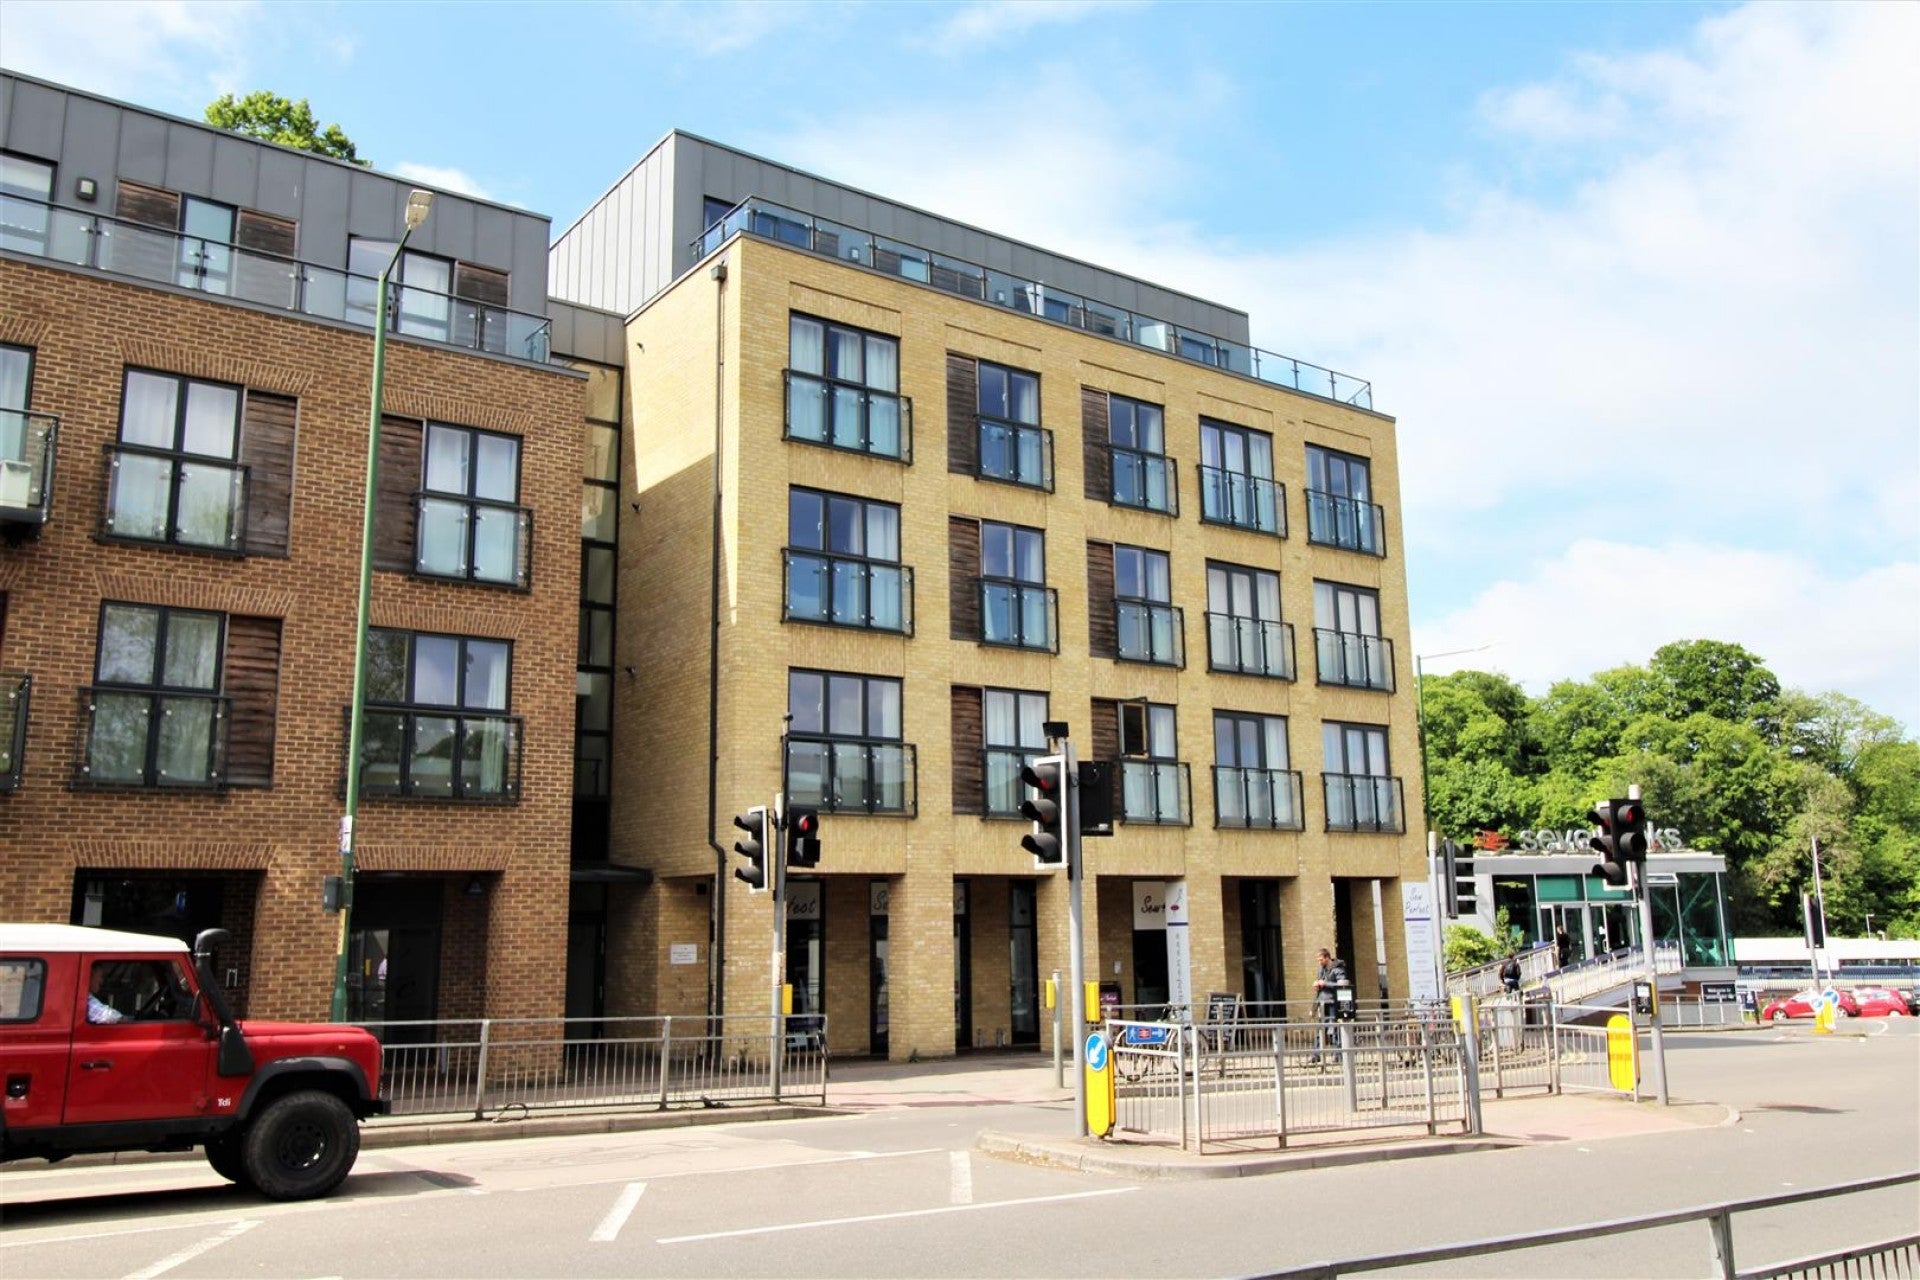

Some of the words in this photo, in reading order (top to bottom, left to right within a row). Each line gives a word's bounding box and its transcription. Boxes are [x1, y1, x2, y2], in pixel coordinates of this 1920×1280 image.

[1519, 821, 1682, 851] seveks
[787, 895, 816, 914] fect
[874, 890, 889, 910] Se
[1141, 895, 1161, 913] Sew
[217, 1098, 231, 1107] Tdi
